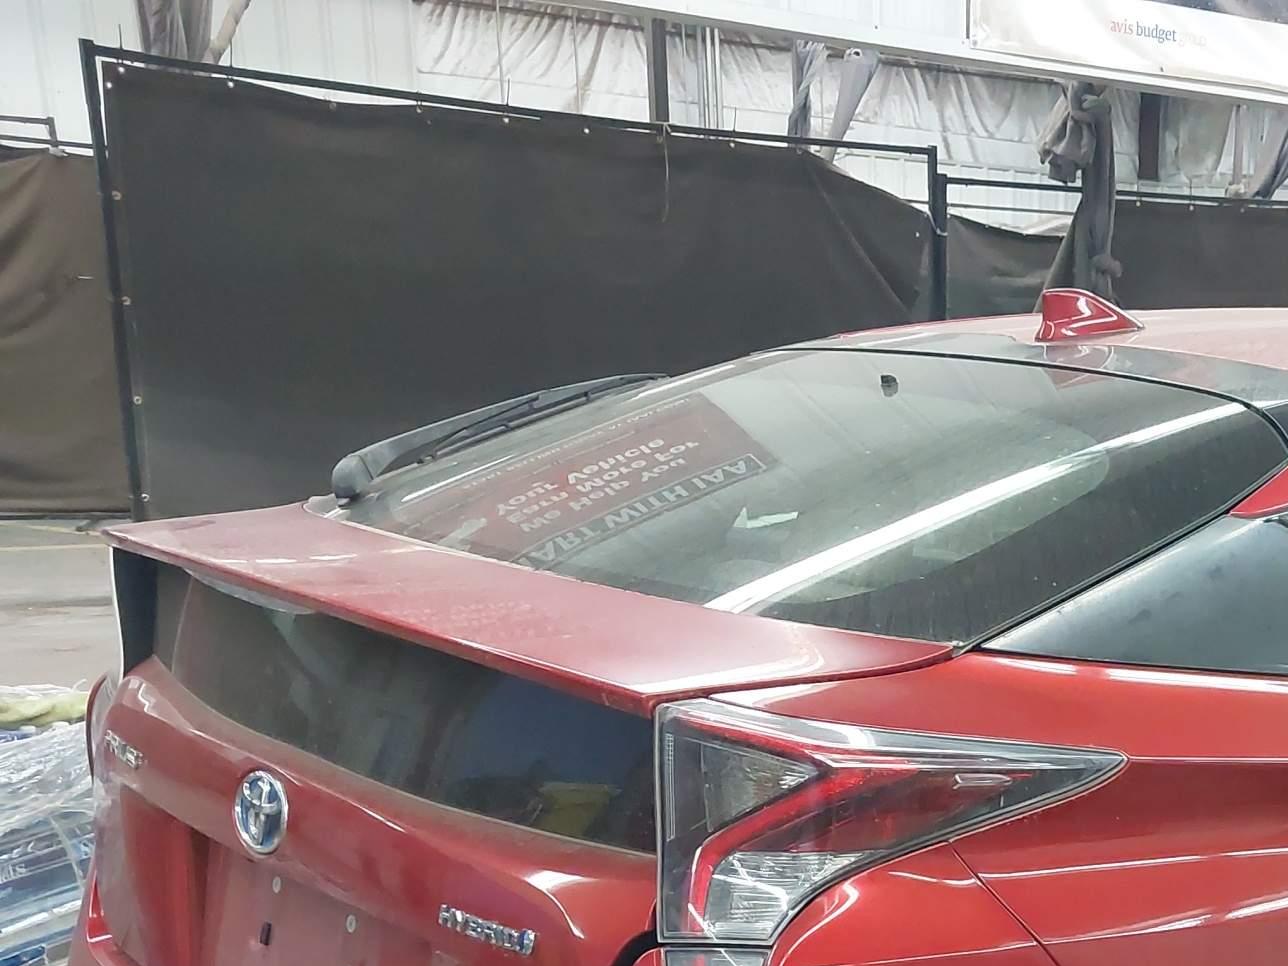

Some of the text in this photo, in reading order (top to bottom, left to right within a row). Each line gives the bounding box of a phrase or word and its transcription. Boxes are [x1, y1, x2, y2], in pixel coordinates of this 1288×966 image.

[1110, 19, 1134, 36] avis
[1136, 21, 1177, 44] budget
[438, 904, 521, 951] HYBRID
